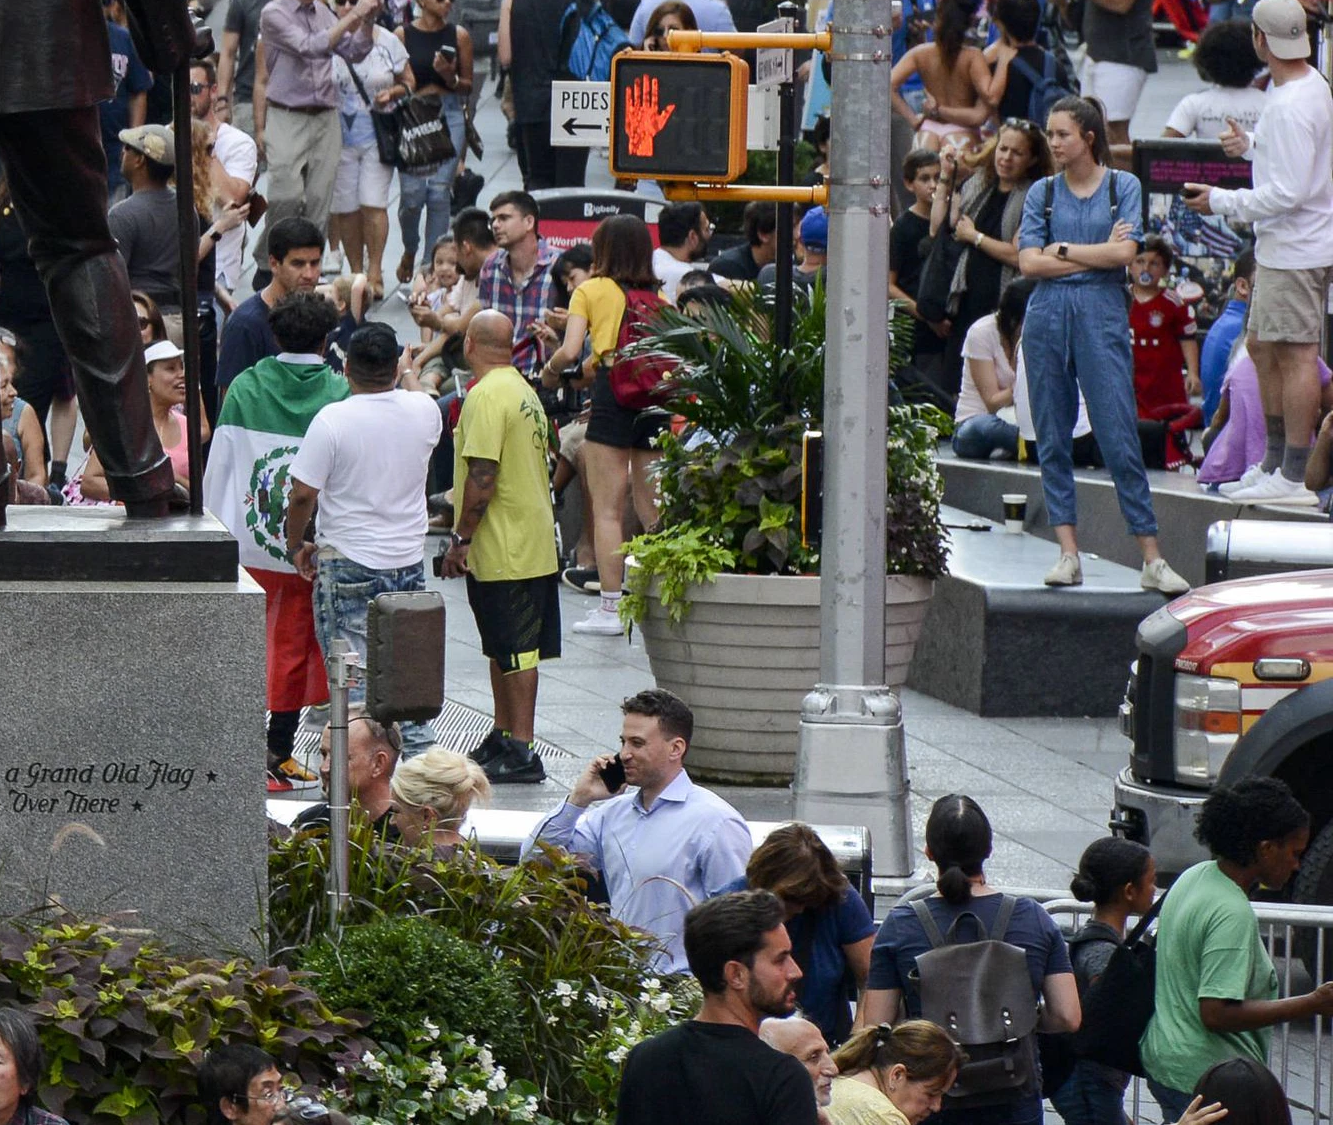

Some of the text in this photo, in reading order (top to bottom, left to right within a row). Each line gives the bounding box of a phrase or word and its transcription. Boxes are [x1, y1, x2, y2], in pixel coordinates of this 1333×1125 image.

[561, 90, 610, 110] PEDES
[4, 767, 19, 783] a
[24, 761, 95, 788] Grand
[101, 761, 140, 784] Old
[144, 759, 195, 791] Flag
[8, 789, 120, 814] Over There
